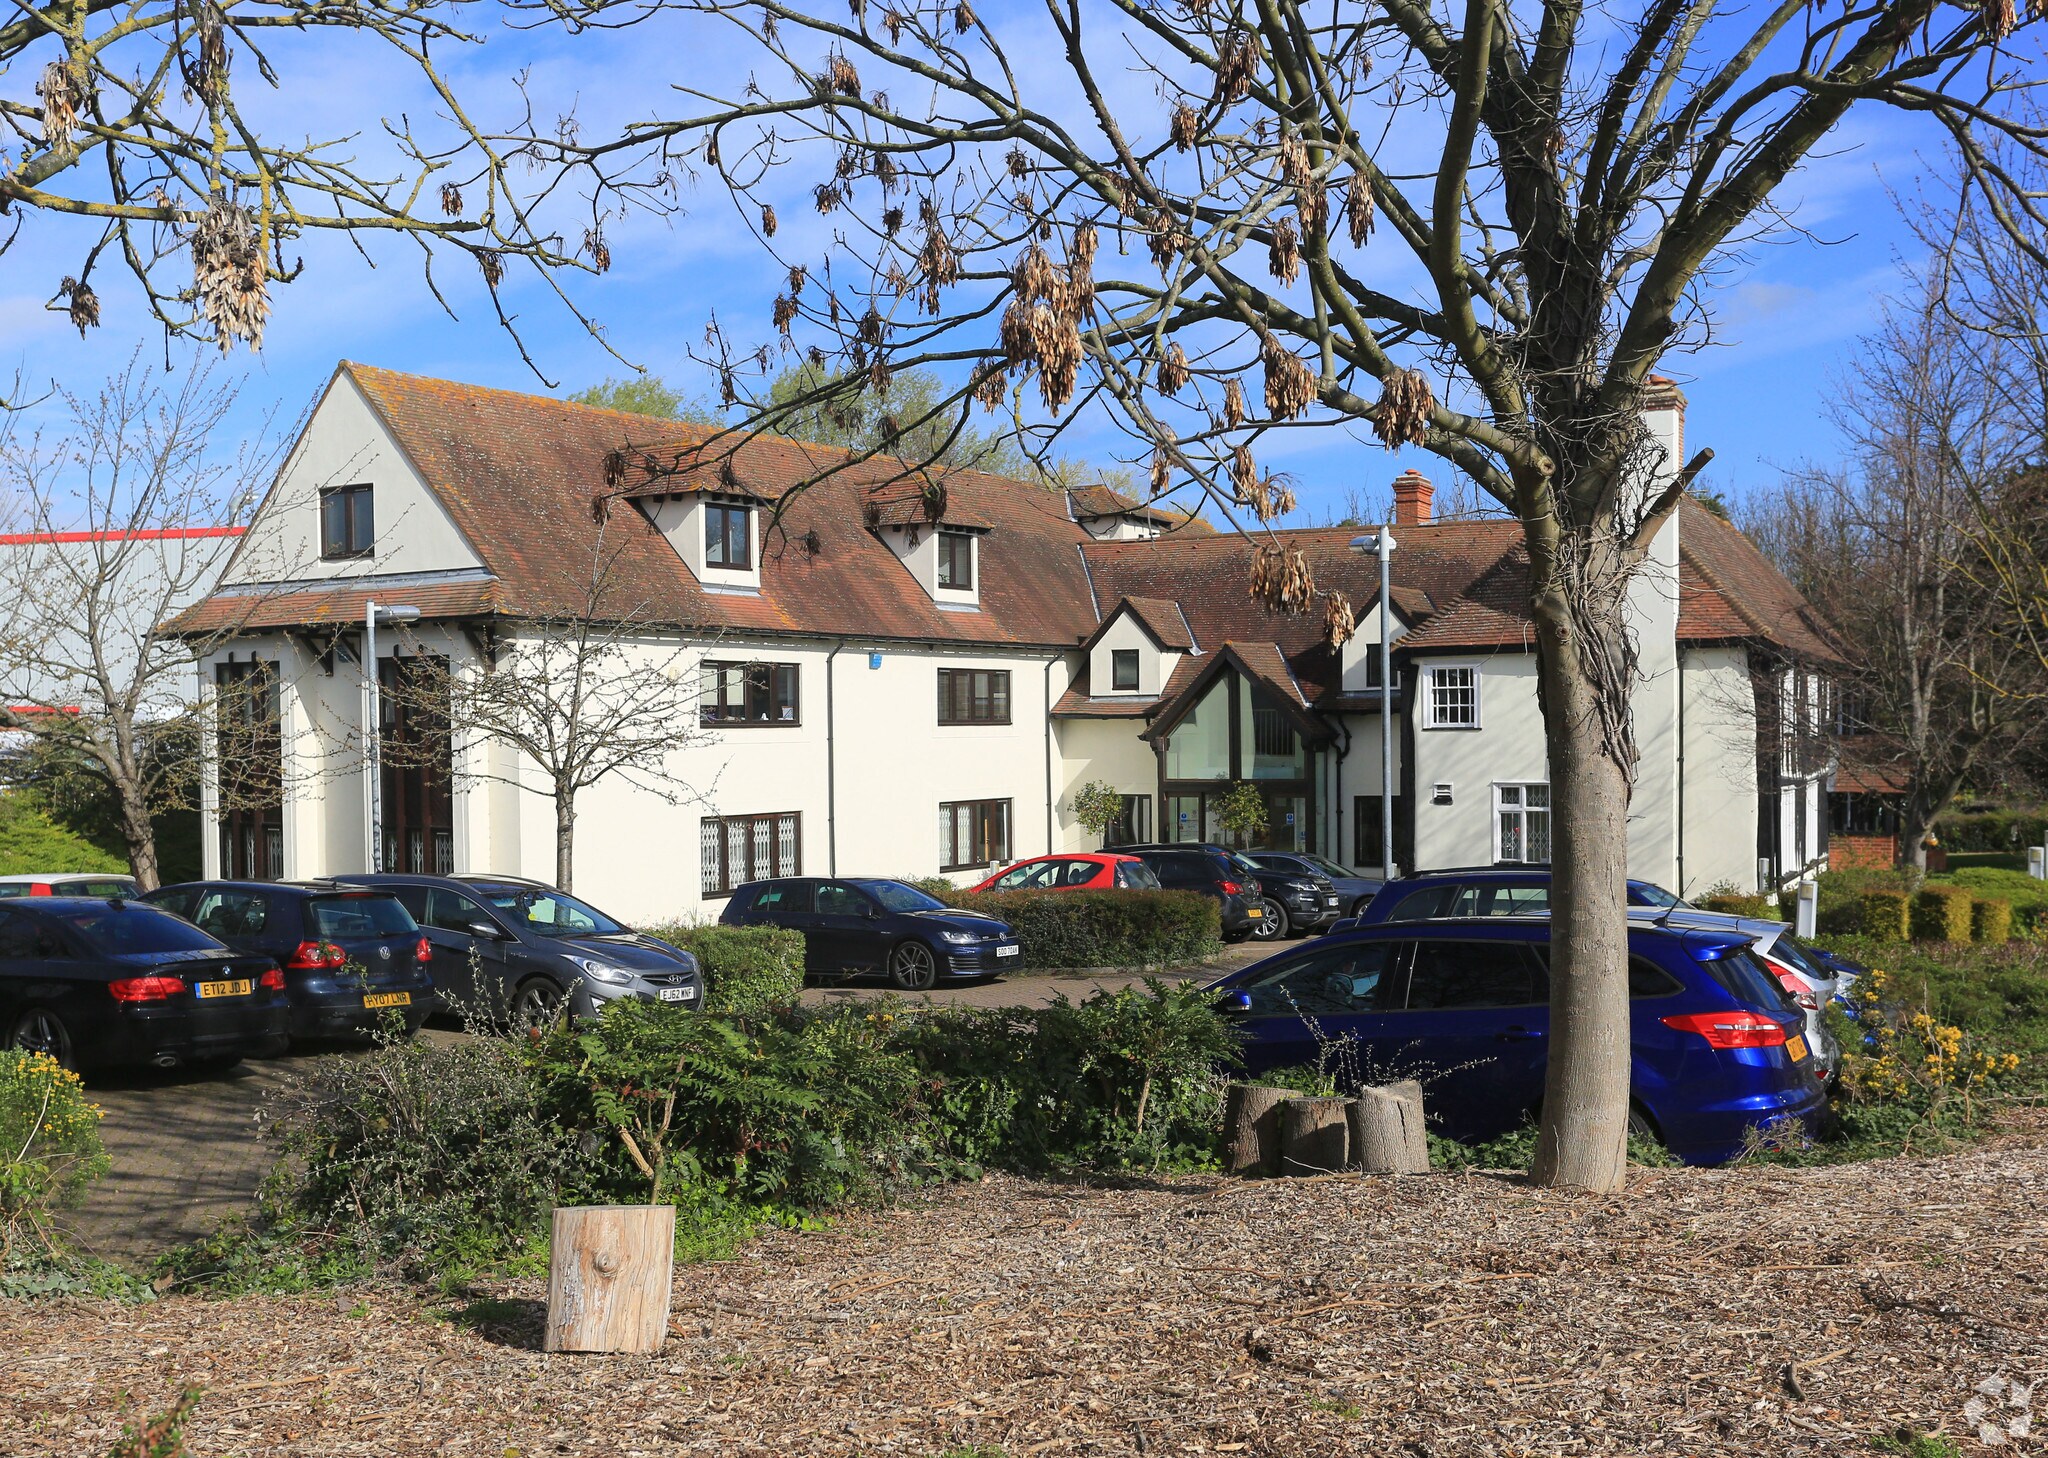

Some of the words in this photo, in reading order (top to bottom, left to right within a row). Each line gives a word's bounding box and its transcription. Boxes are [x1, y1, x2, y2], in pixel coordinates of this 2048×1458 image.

[203, 983, 226, 996] ET12
[229, 981, 247, 994] JDJ
[662, 989, 680, 1000] EJ62
